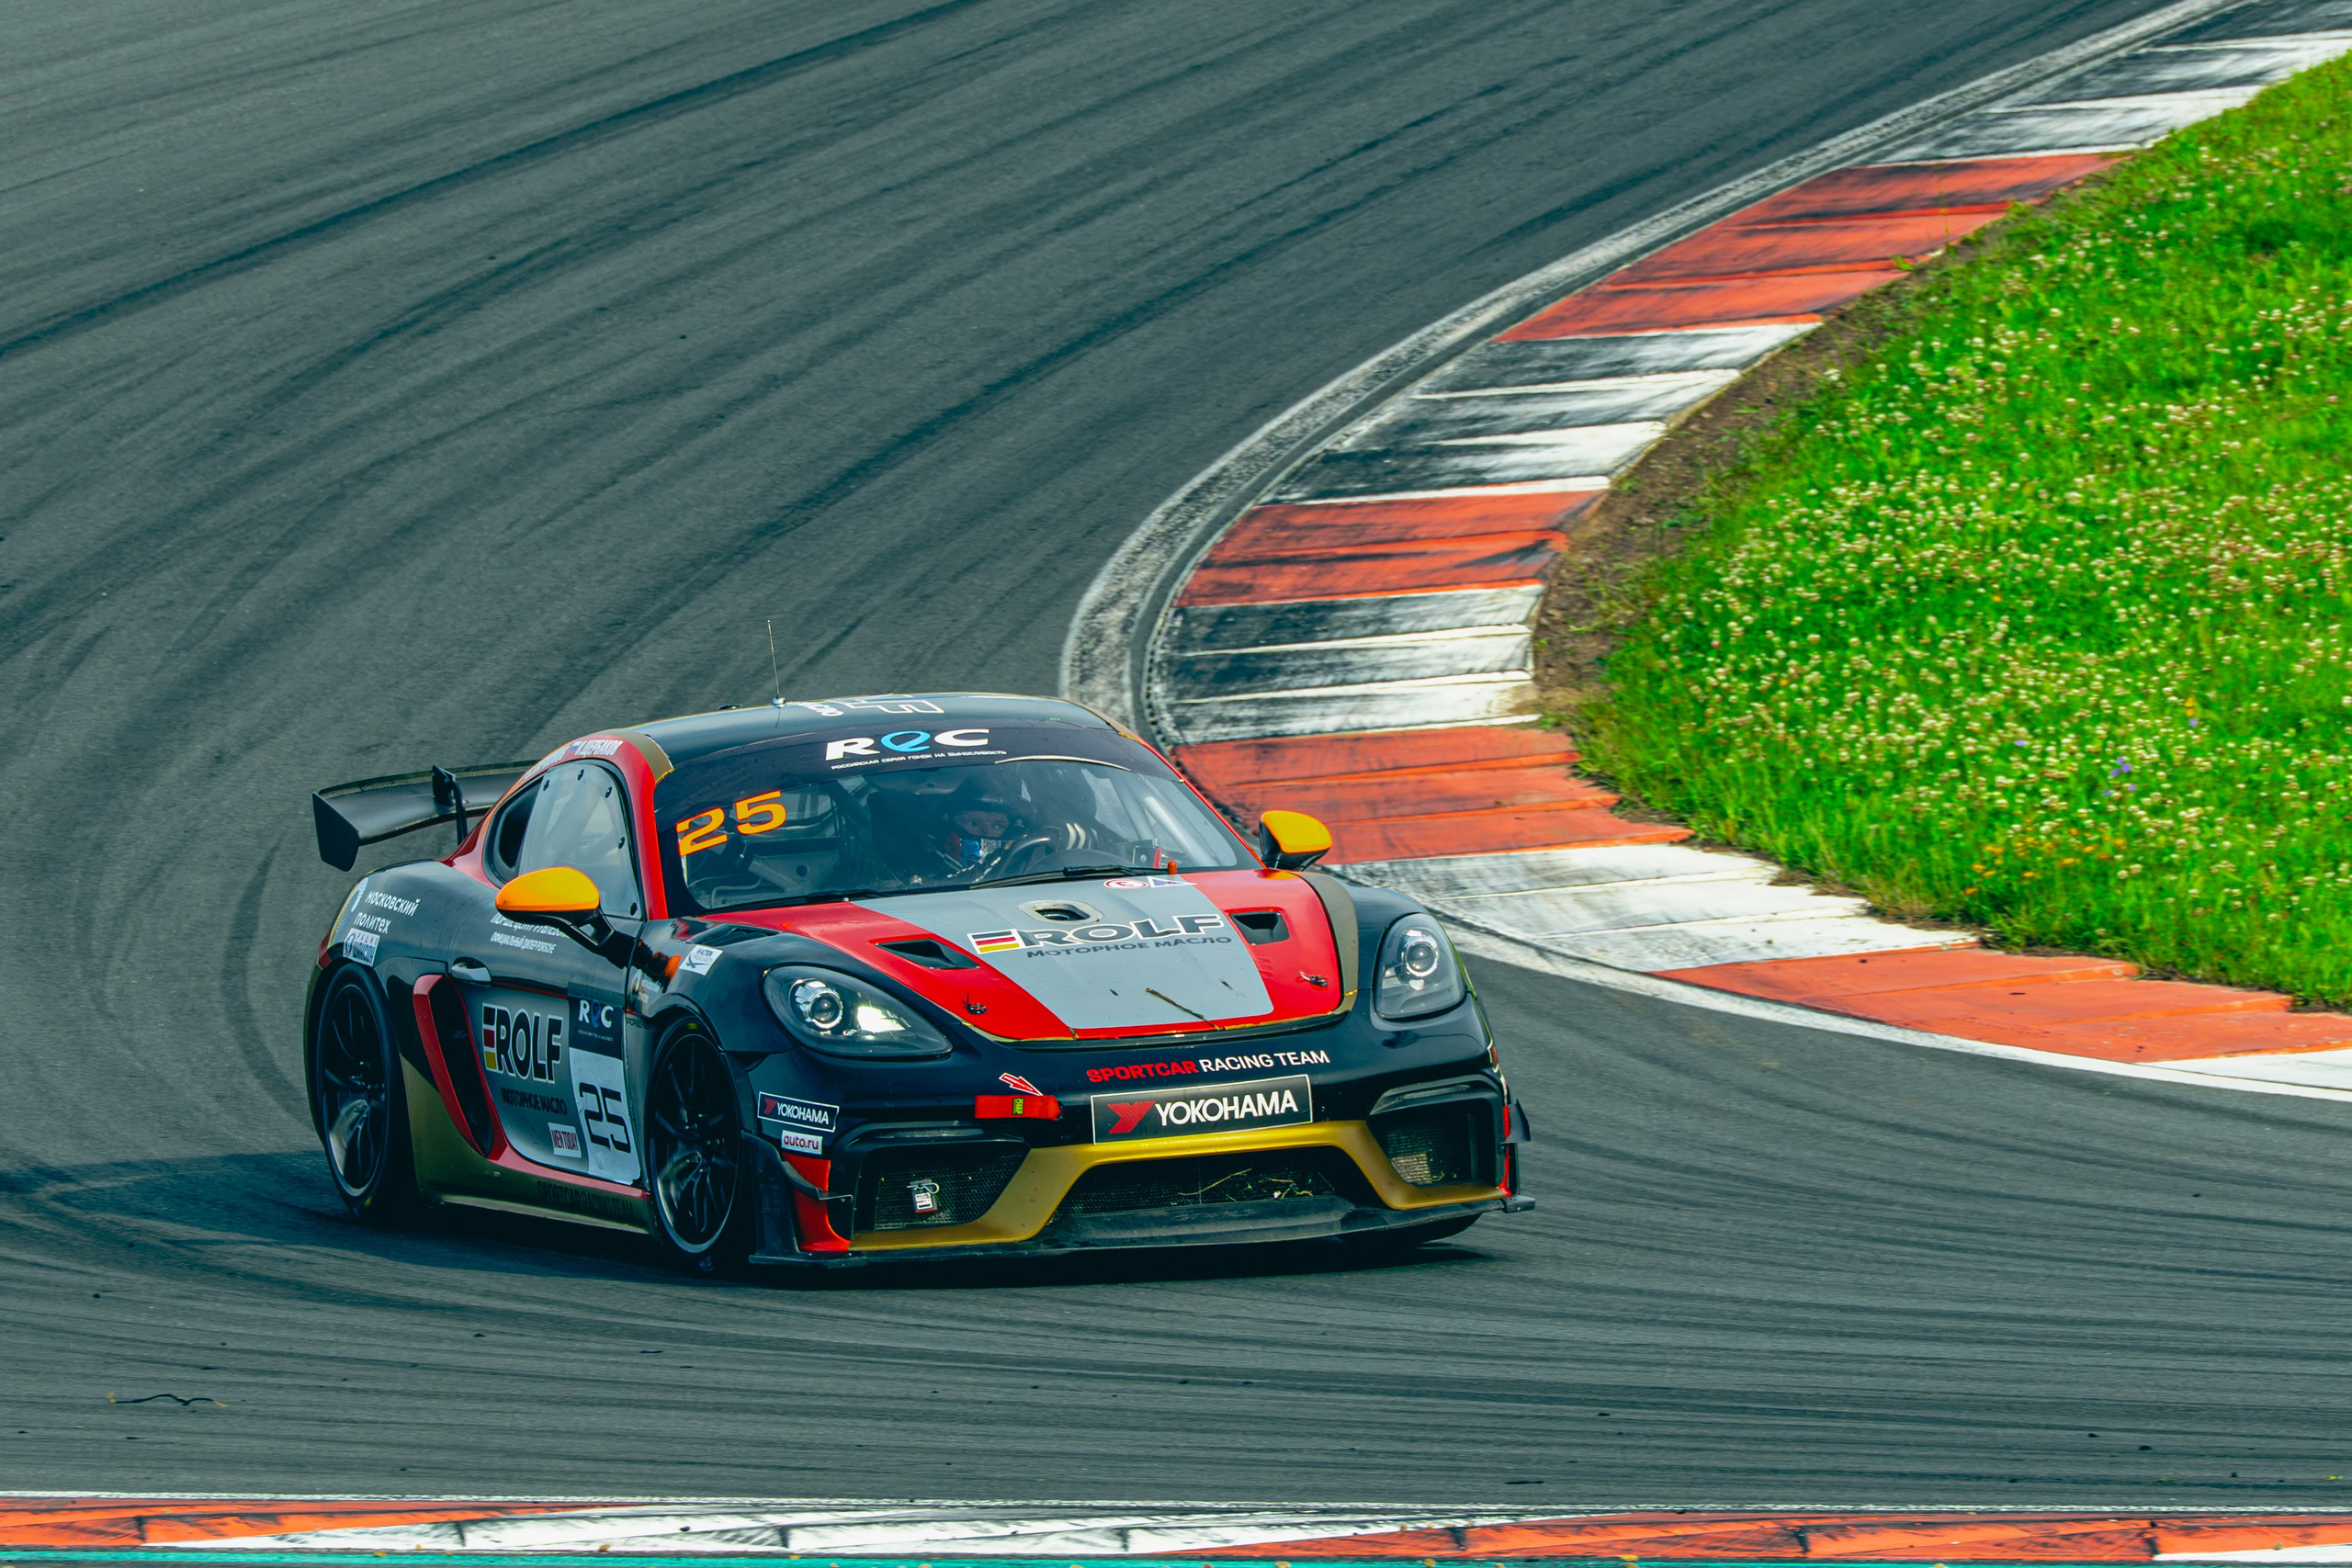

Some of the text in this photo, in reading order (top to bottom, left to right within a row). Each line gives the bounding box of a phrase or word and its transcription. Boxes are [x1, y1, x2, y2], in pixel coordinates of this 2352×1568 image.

[831, 759, 879, 770] РОССИЙСКАЯ
[675, 790, 786, 856] 25
[364, 890, 421, 917] МОСКОВСКИЙ
[1014, 913, 1225, 948] ROLF
[1026, 936, 1232, 958] МОТОРНОЕ МАСЛО
[494, 1005, 564, 1085] ROLF
[1086, 1050, 1330, 1083] SPORTCAR RACING TEAM
[501, 1087, 568, 1115] МОТОРНОЕ МАСЛО
[776, 1102, 830, 1125] YOKOHAMA
[1154, 1089, 1299, 1126] YOKOHAMA
[579, 1082, 631, 1154] 25
[783, 1135, 819, 1150] auto.ru
